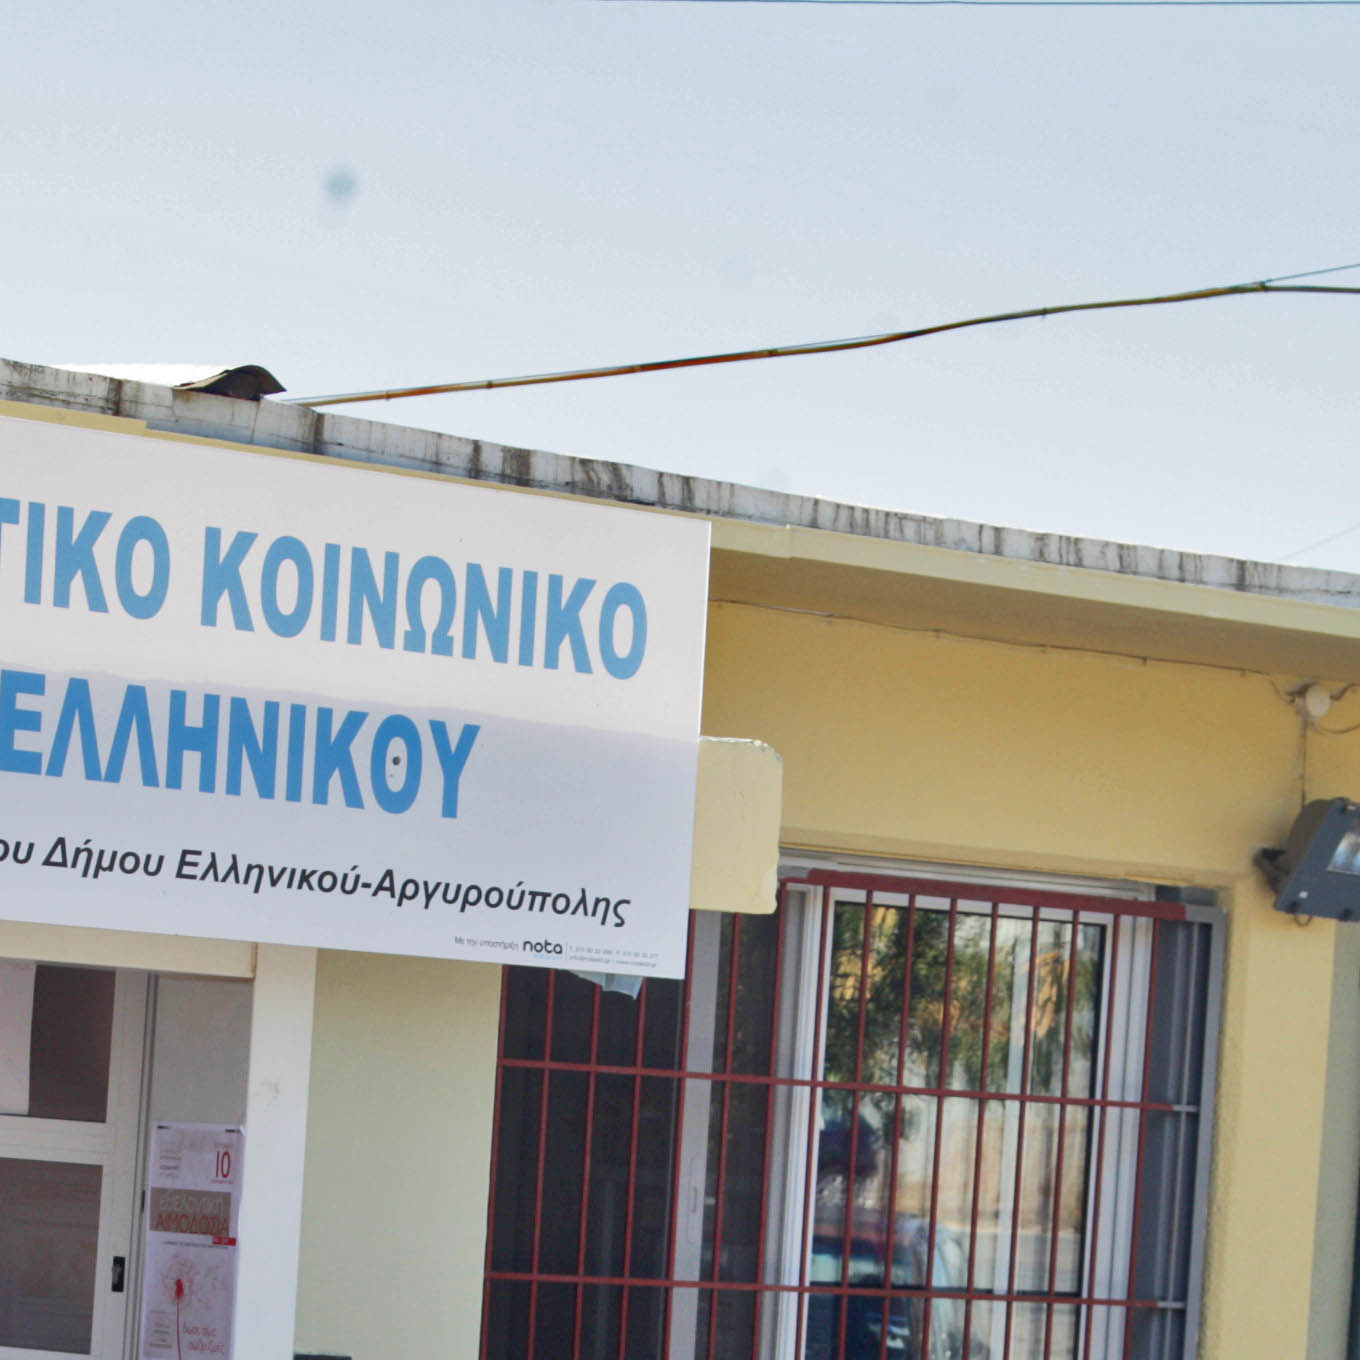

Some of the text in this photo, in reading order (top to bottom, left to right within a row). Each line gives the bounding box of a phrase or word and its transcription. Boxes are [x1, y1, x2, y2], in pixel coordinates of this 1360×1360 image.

[201, 526, 647, 681] ΚΟΙΝΩΝΙΚΟ
[40, 835, 166, 880] Δήμου
[174, 848, 632, 929] Ελληνικού-Αργυρούπολης
[522, 939, 564, 955] nota
